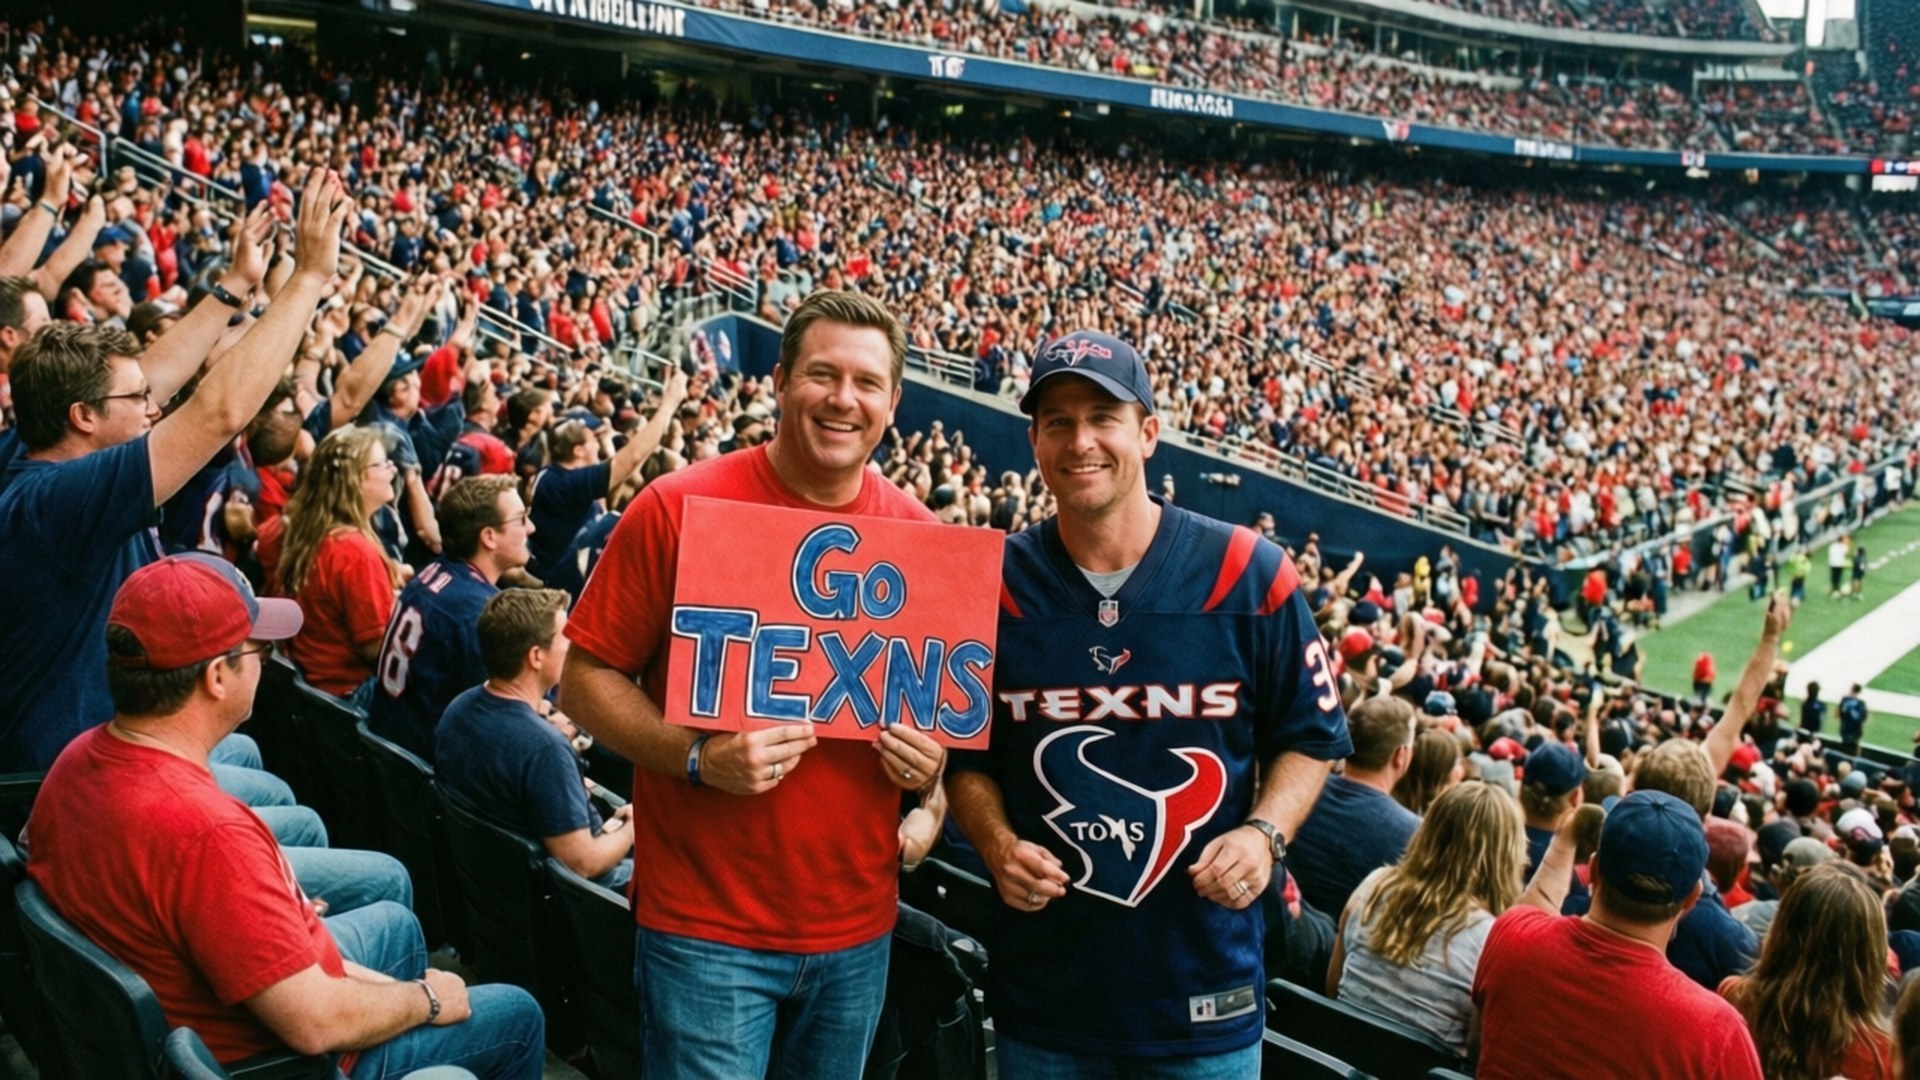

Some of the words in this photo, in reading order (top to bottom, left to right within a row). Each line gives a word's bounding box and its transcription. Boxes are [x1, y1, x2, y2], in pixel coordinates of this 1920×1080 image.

[791, 523, 907, 620] Go
[671, 606, 993, 739] TEXNS
[998, 682, 1242, 721] TEXNS
